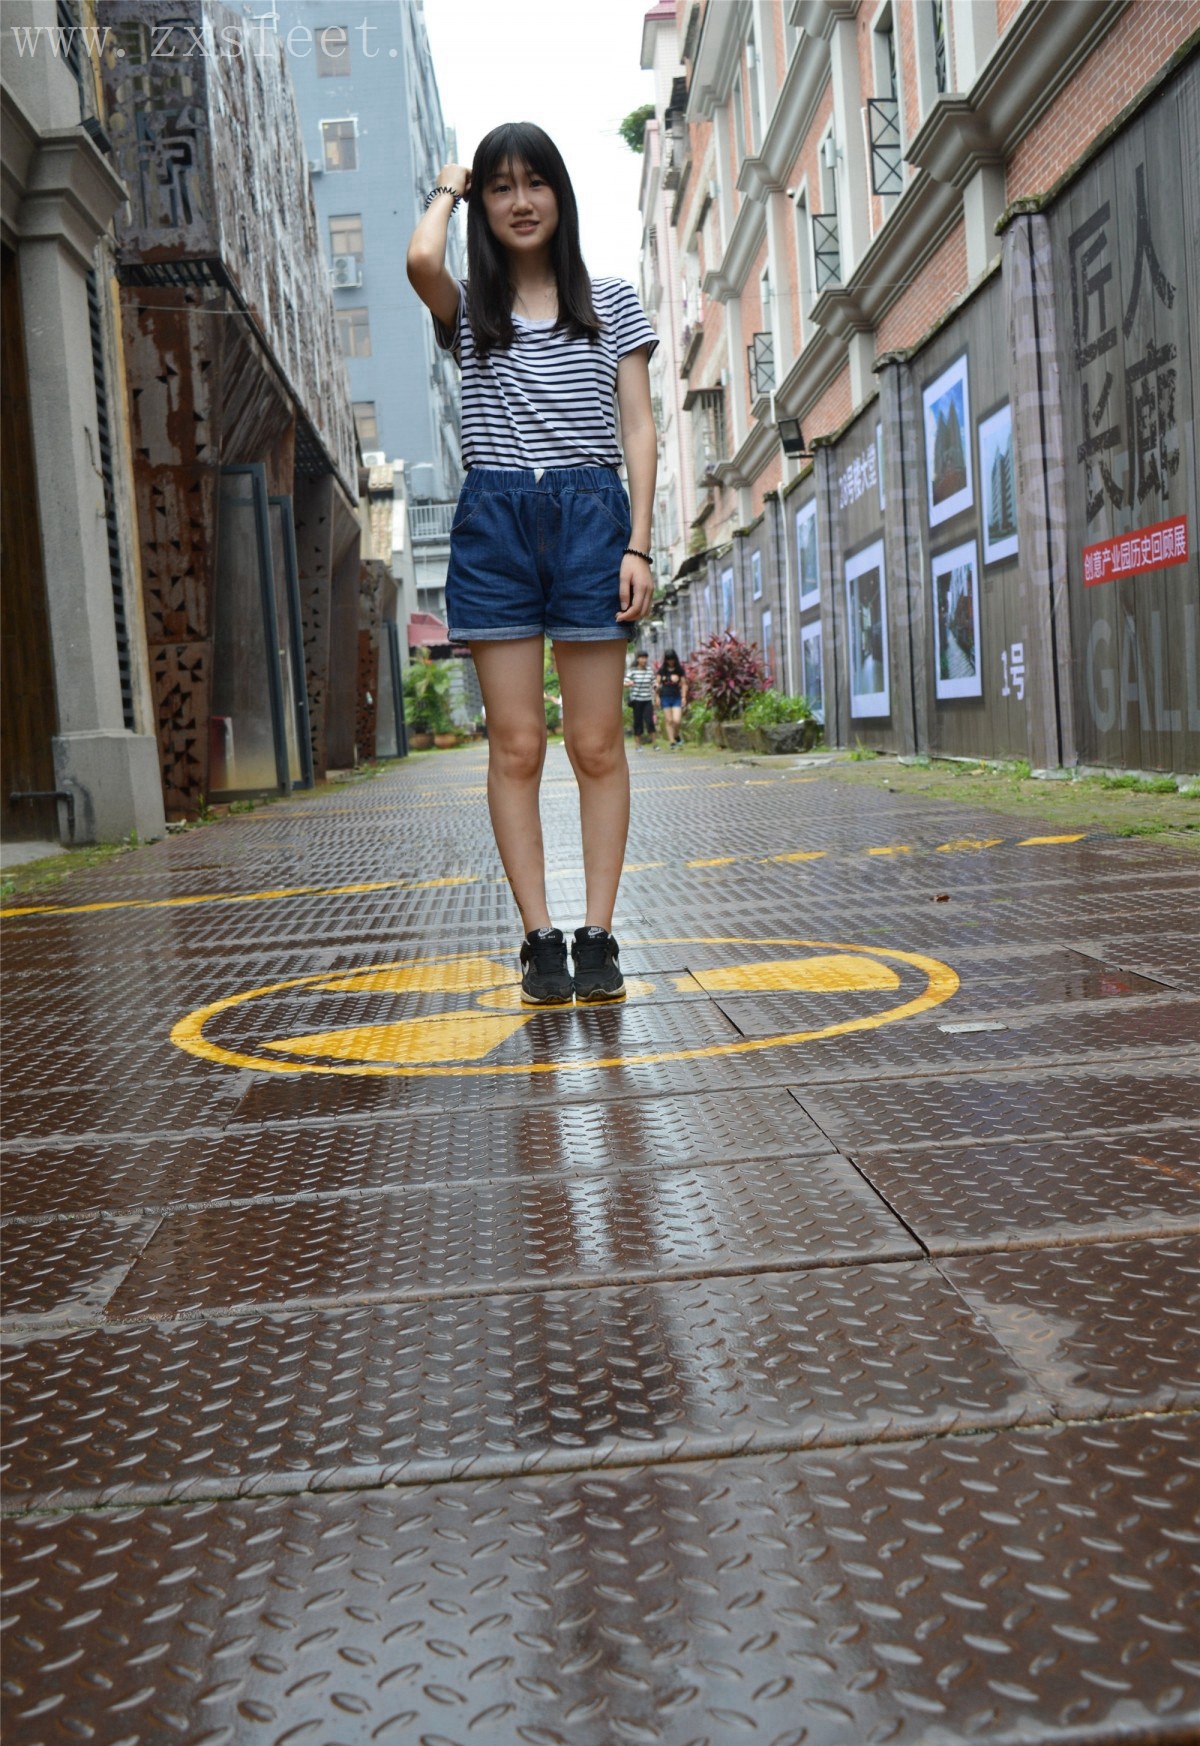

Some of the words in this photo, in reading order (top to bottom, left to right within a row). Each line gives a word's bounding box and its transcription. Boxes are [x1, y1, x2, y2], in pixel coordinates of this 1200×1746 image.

[1084, 524, 1186, 581] 创意产业园历史回顾展
[1001, 642, 1025, 700] 1号
